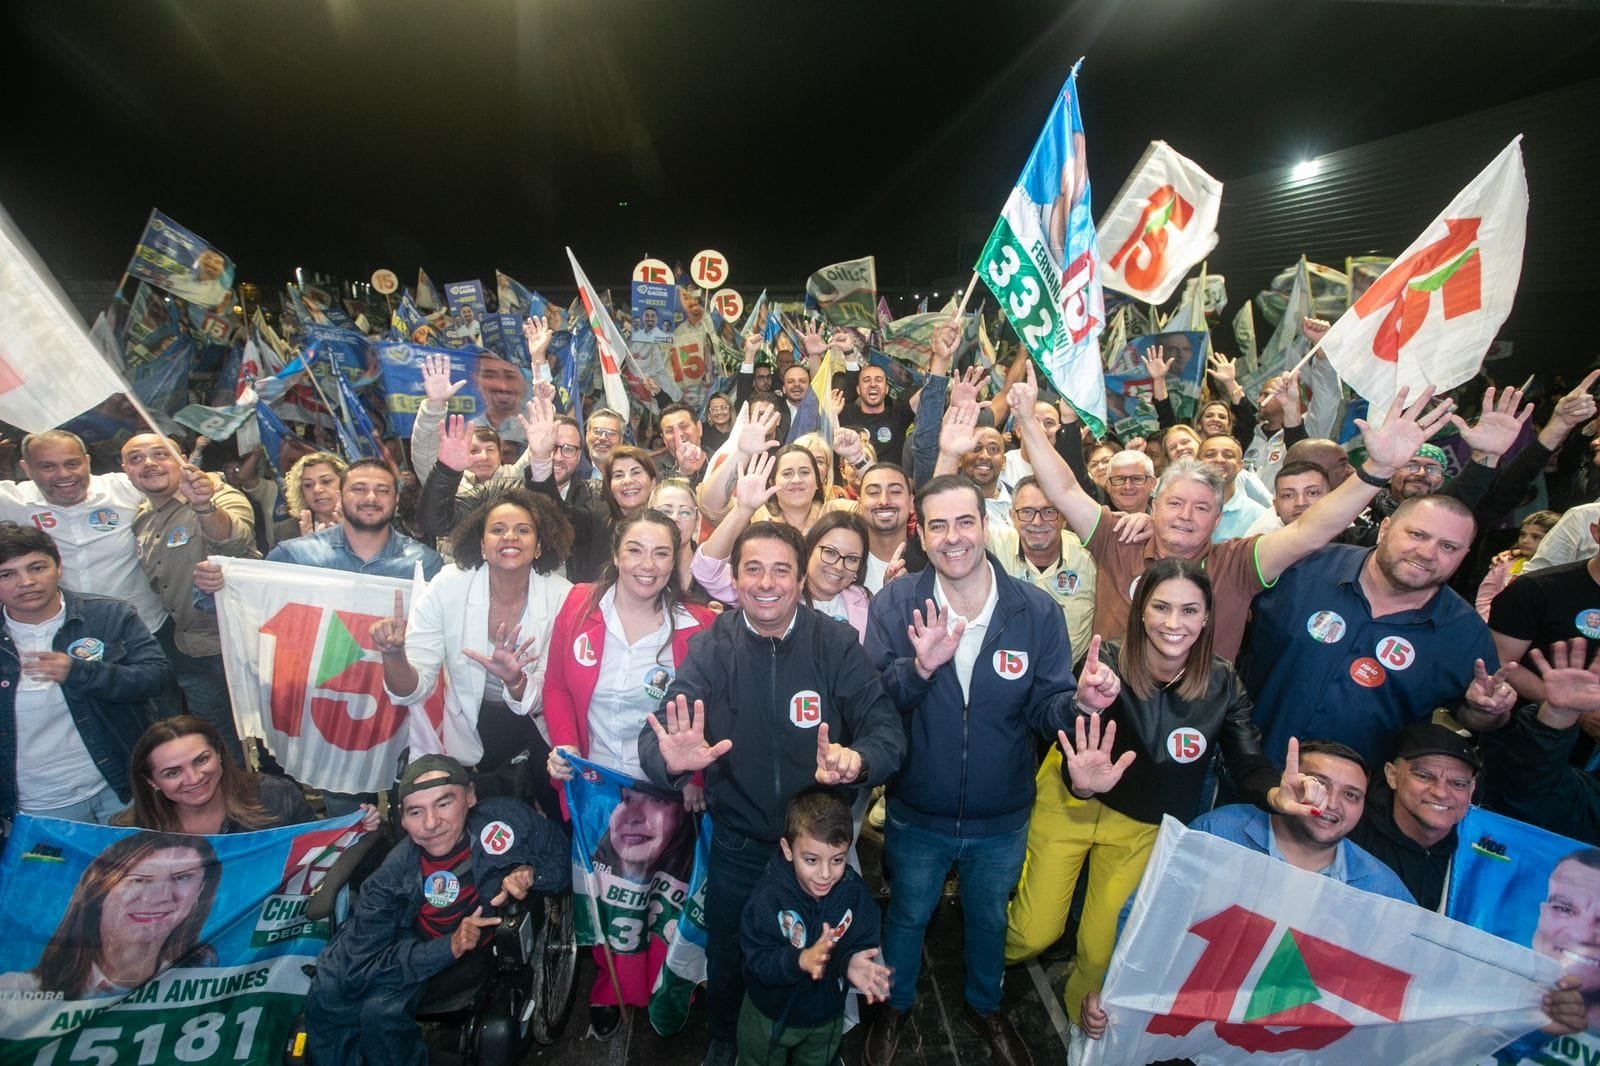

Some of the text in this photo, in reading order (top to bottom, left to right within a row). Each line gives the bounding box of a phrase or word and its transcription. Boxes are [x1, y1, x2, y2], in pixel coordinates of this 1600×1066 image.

[1108, 185, 1194, 292] 15
[374, 272, 394, 289] 15
[697, 256, 722, 282] 15
[715, 294, 739, 317] 15
[669, 342, 705, 383] 15
[1269, 451, 1280, 462] 15
[31, 511, 57, 530] 15
[999, 650, 1023, 674] 15
[1379, 638, 1411, 667] 15
[258, 601, 410, 752] 15
[793, 696, 820, 722] 15
[1172, 733, 1201, 758] 15
[484, 824, 511, 852] 15
[163, 967, 270, 1003] ANTUNES
[1145, 903, 1416, 1054] 15
